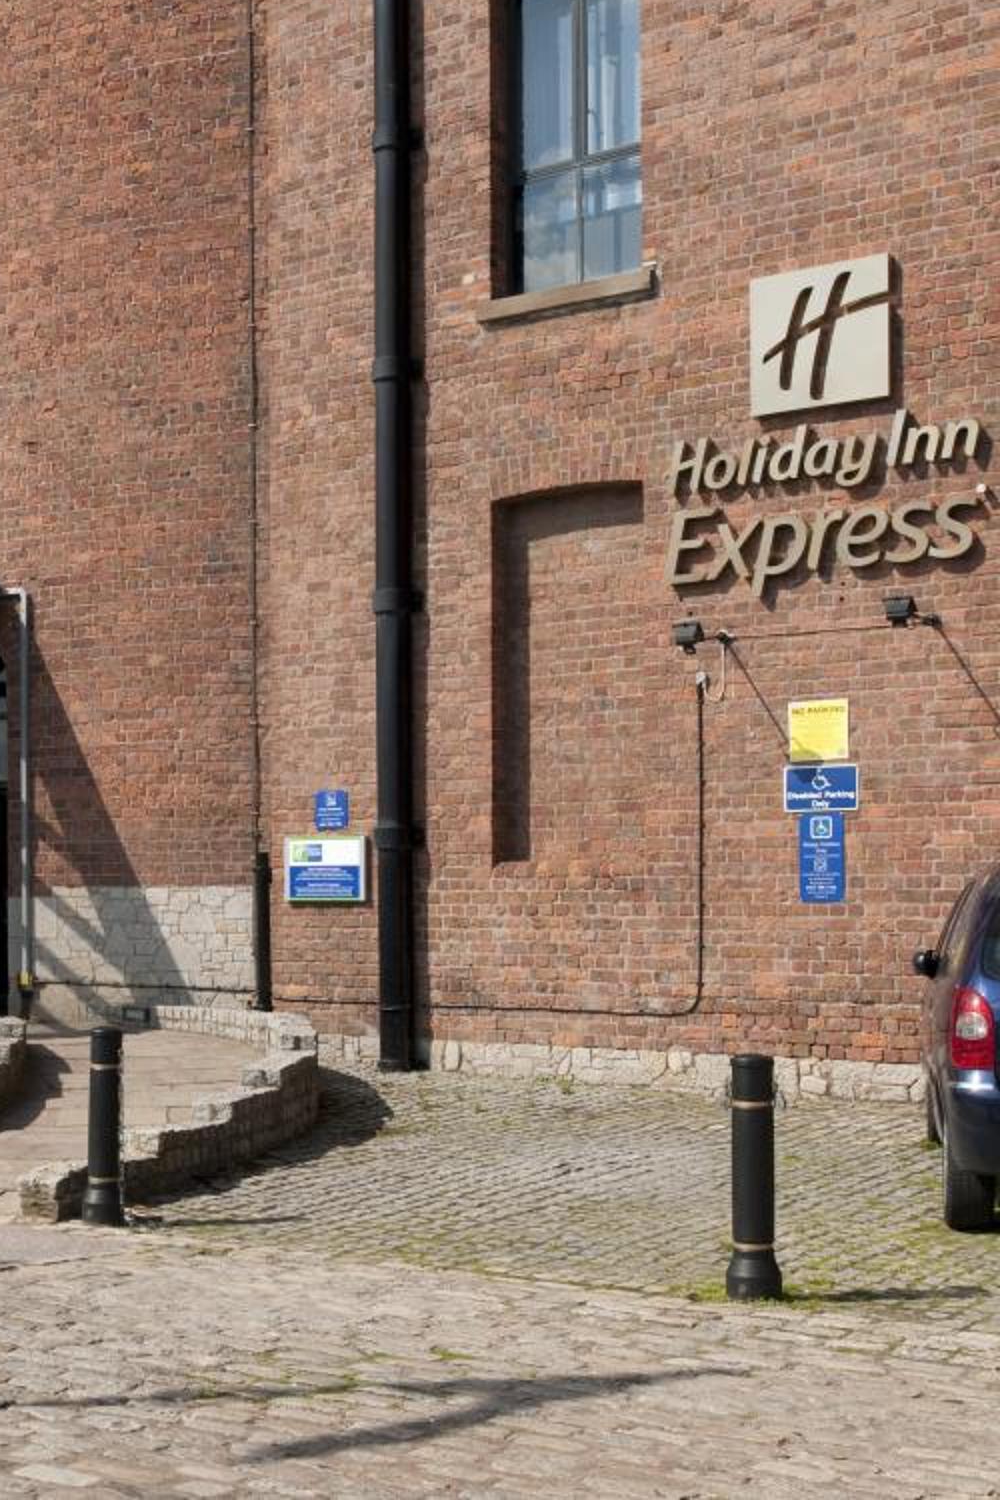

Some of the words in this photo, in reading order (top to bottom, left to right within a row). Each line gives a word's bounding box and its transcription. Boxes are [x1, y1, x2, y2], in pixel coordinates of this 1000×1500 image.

[668, 424, 877, 494] Holiday
[886, 408, 980, 467] Inn
[666, 499, 980, 598] Express
[824, 789, 855, 799] Parking
